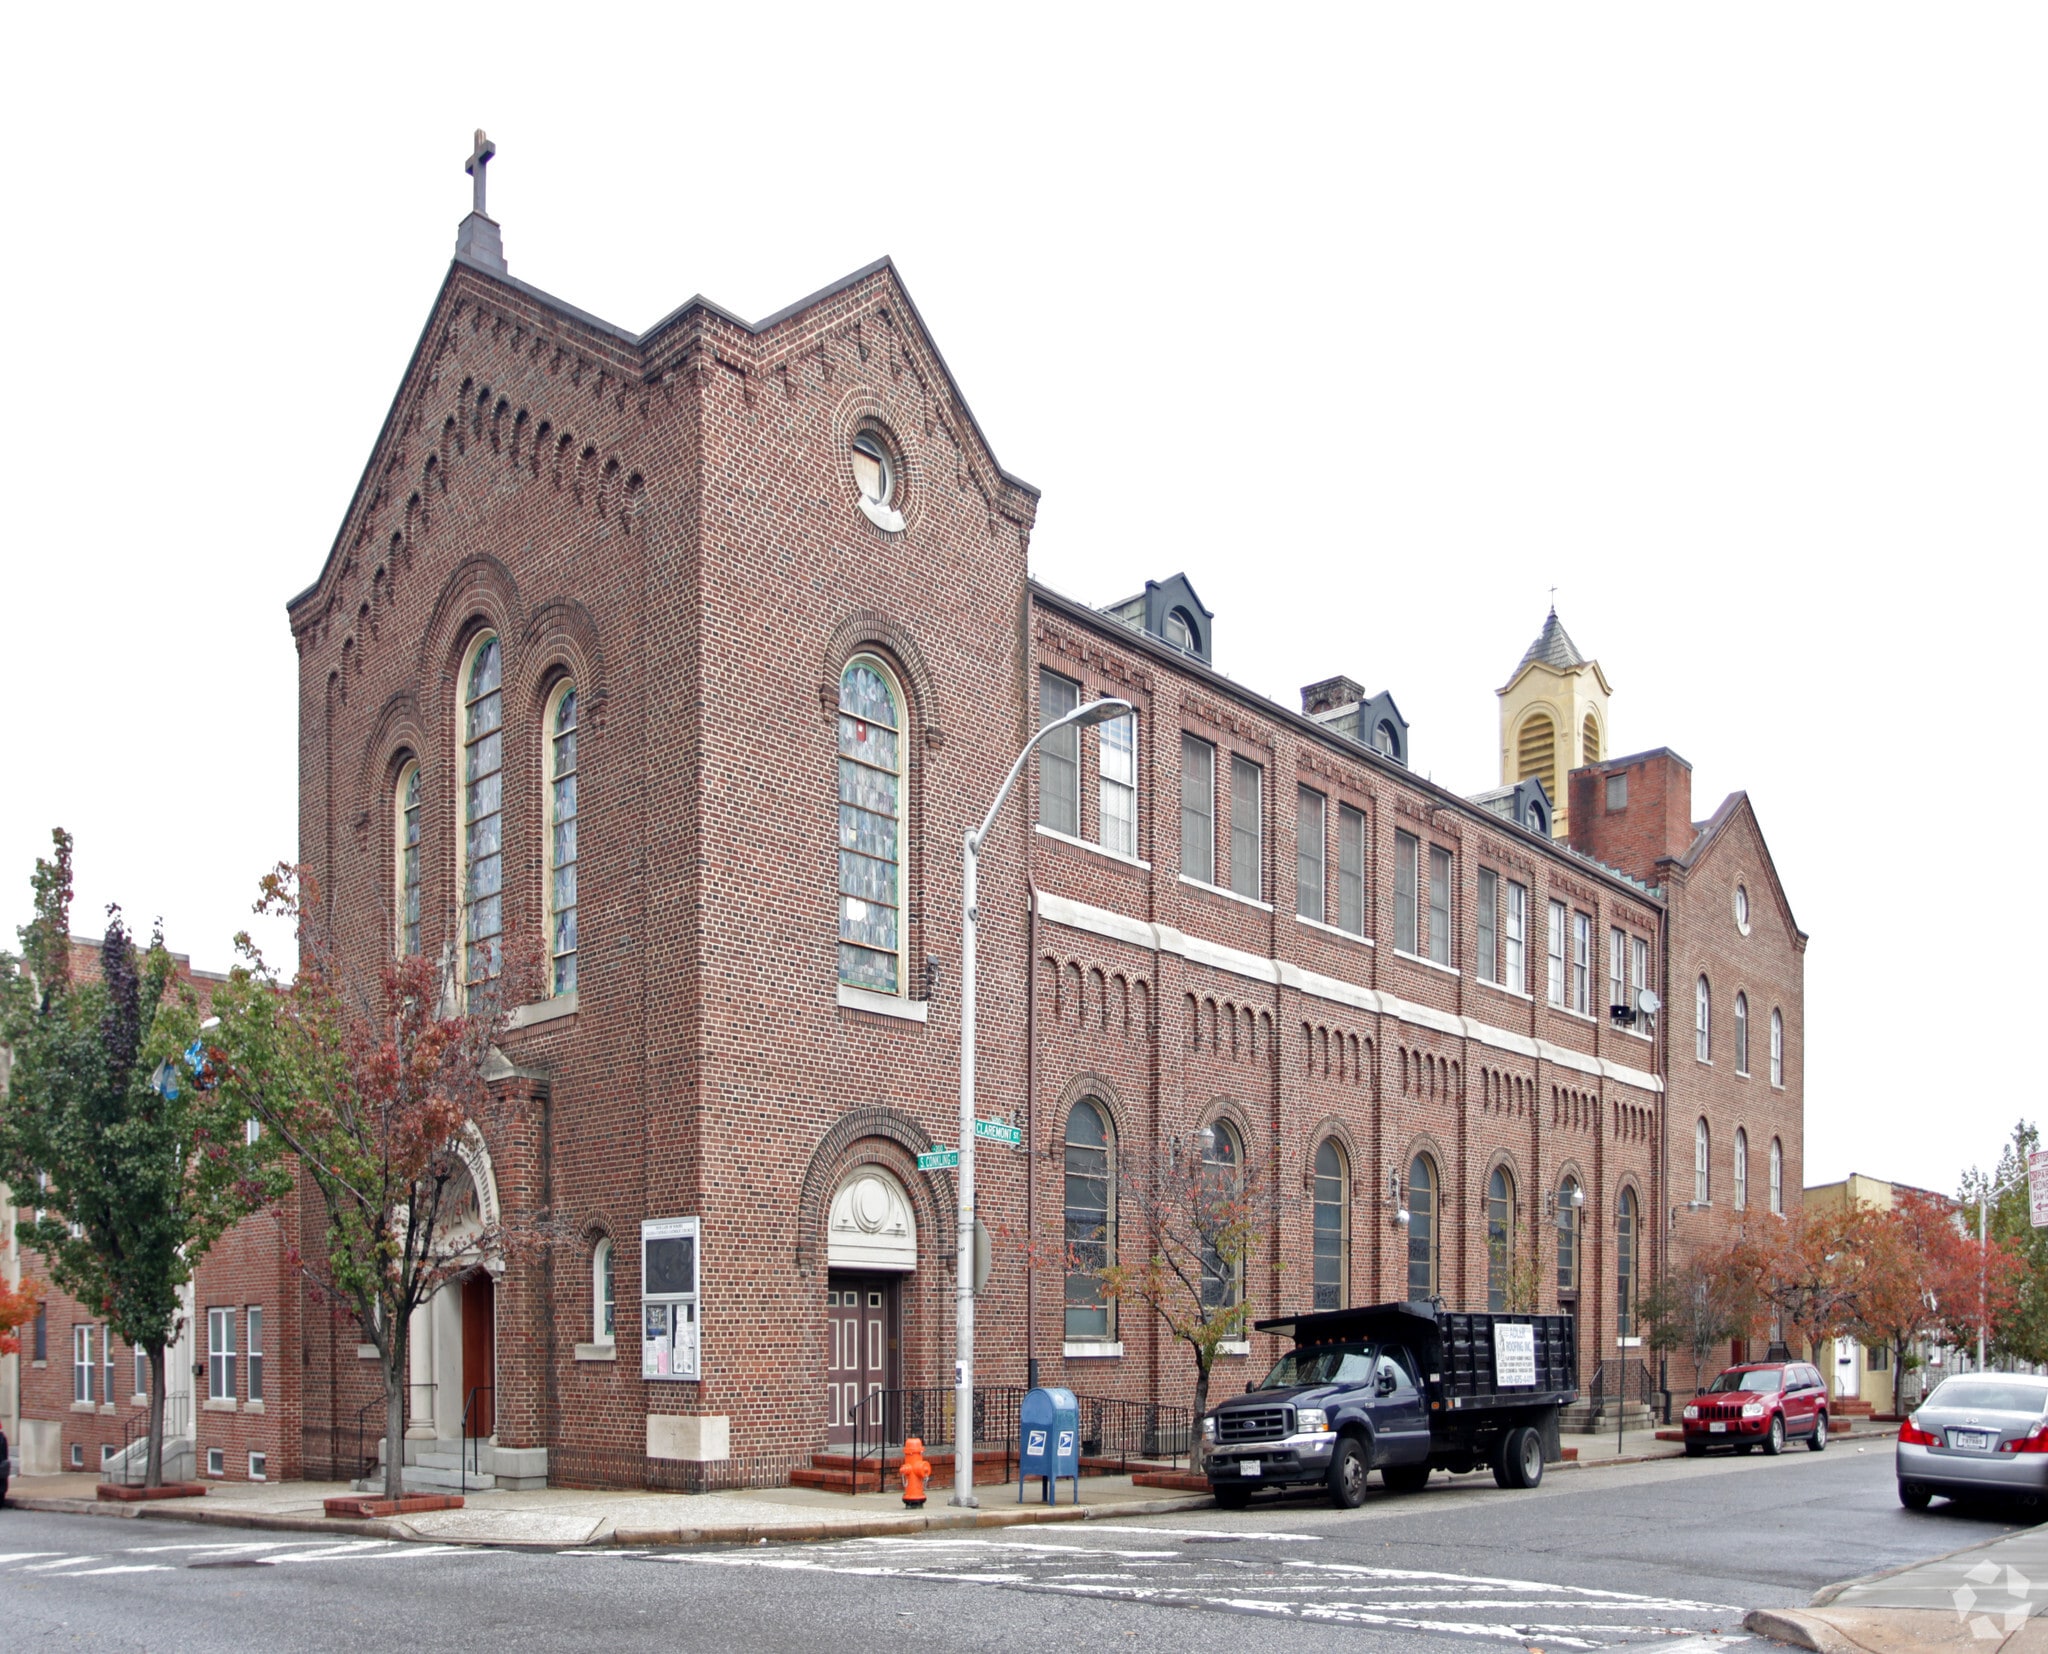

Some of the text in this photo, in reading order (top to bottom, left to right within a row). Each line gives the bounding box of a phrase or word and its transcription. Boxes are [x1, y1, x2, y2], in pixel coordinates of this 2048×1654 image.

[976, 1122, 1012, 1140] CLAREMONT
[926, 1153, 951, 1167] CONKLING
[1506, 1341, 1524, 1352] ROOFING
